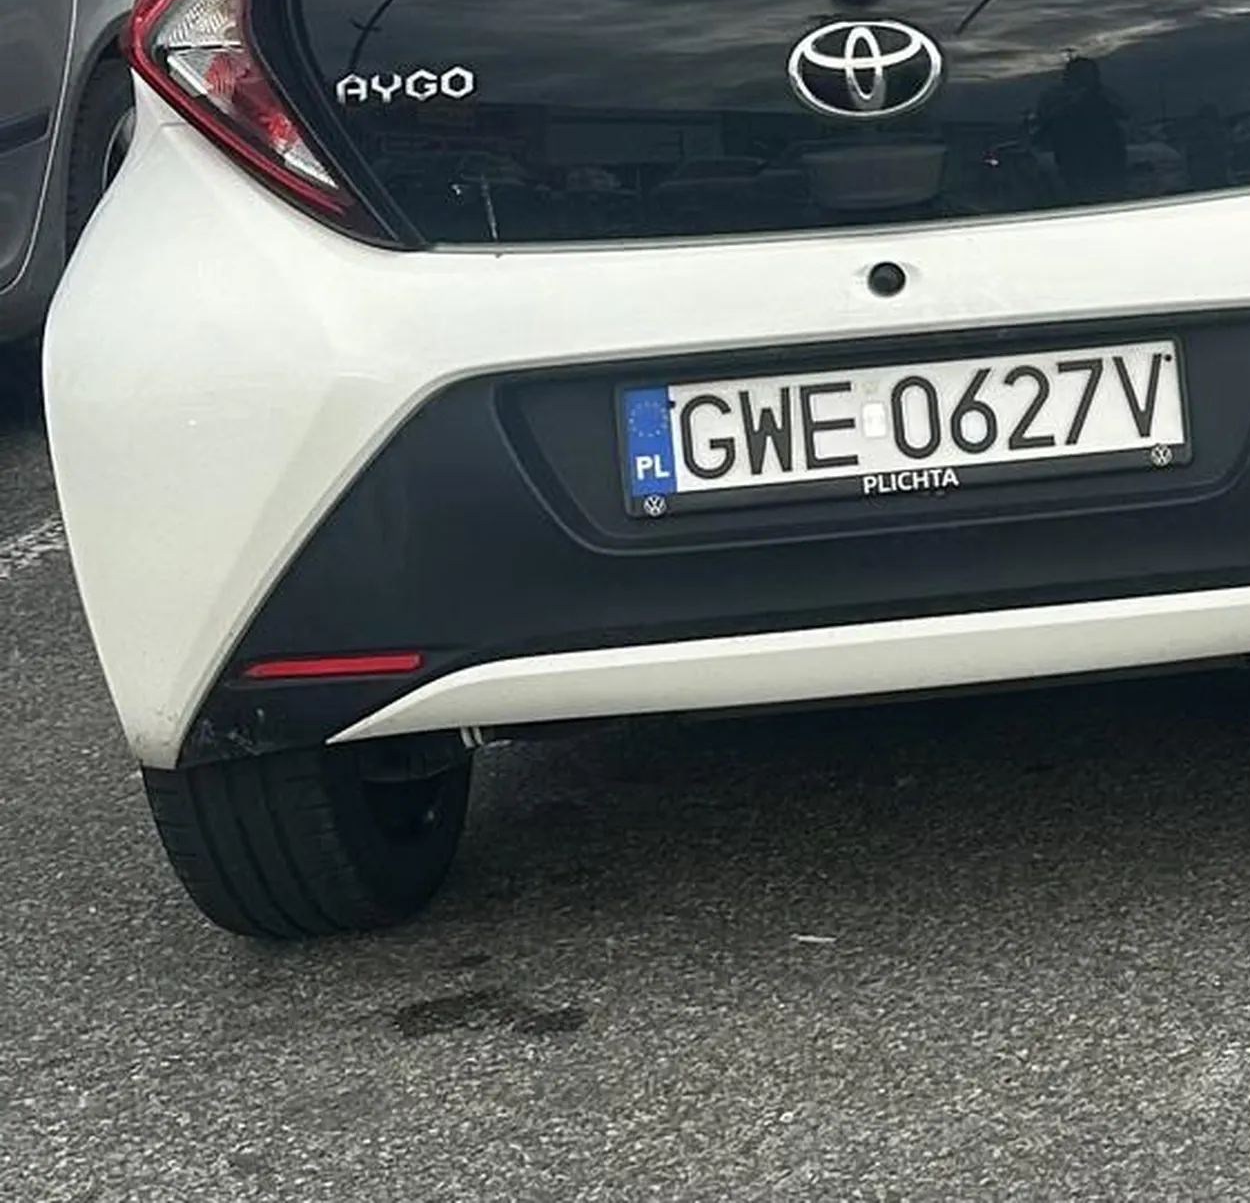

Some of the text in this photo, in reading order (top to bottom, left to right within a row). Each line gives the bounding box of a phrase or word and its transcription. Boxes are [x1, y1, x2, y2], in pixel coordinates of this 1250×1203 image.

[335, 65, 475, 105] AYGO
[680, 353, 1163, 481] GWE 0627V
[635, 454, 670, 481] PL
[863, 467, 959, 495] PLICHTA
